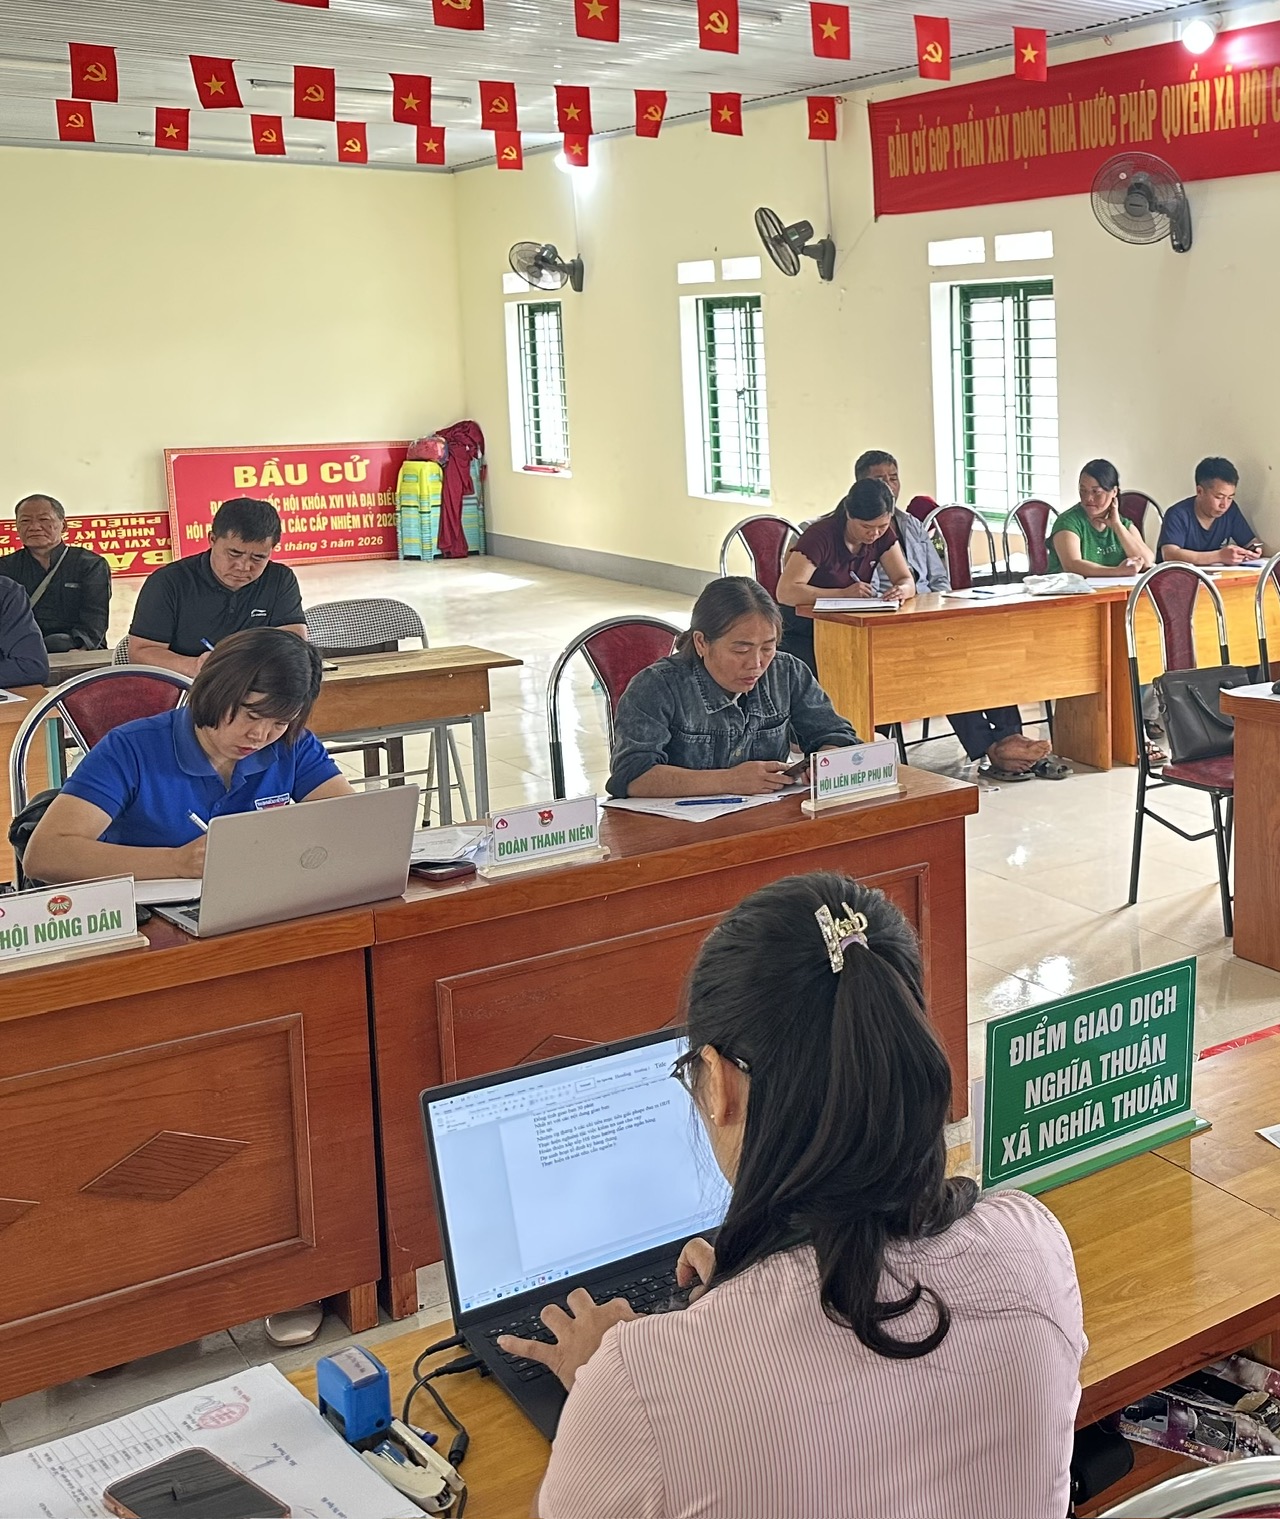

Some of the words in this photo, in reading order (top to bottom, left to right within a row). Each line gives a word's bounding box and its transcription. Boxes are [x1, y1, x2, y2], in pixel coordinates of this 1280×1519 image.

[888, 119, 909, 178] BẦU
[912, 114, 926, 175] CỬ
[929, 117, 950, 172] GÓP
[953, 104, 985, 168] PHẦN
[987, 105, 1009, 164] XÂY
[1013, 105, 1047, 170] DỰNG
[1049, 93, 1077, 154] NHÀ
[1079, 87, 1116, 150] NƯỚC
[1119, 79, 1157, 144] PHÁP
[1161, 63, 1210, 144] QUYỀN
[1213, 64, 1236, 131] XÃ
[1240, 65, 1267, 138] HỘI
[233, 457, 308, 488] BẦU
[320, 454, 371, 483] CỬ
[283, 494, 300, 515] HỘI
[301, 493, 327, 510] KHÓA
[329, 494, 344, 509] XVI
[345, 490, 358, 508] VÀ
[359, 493, 376, 510] ĐẠI
[101, 527, 155, 539] NHIỆM
[186, 521, 203, 542] HỘI
[288, 515, 307, 533] CÁC
[309, 511, 328, 531] CẤP
[330, 512, 361, 532] NHIỆM
[362, 511, 374, 528] KỲ
[99, 539, 120, 551] VÀ
[125, 538, 150, 548] XVI
[284, 540, 317, 552] tháng
[320, 539, 327, 548] 3
[330, 538, 354, 548] năm
[358, 536, 383, 547] 2026
[820, 775, 832, 793] HỘI
[833, 773, 849, 788] LIÊN
[850, 769, 866, 786] HIỆP
[867, 769, 881, 782] PHỤ
[883, 763, 894, 778] NỮ
[498, 836, 528, 856] ĐOÀN
[530, 830, 566, 850] THANH
[568, 824, 594, 843] NIÊN
[0, 923, 29, 951] HỘI
[34, 917, 82, 944] NÔNG
[87, 908, 122, 934] DÂN
[1009, 1016, 1067, 1066] ĐIỂM
[1073, 1003, 1123, 1045] GIAO
[1129, 985, 1178, 1028] DỊCH
[1025, 1057, 1093, 1110] NGHĨA
[1100, 1033, 1167, 1083] THUẬN
[1001, 1123, 1031, 1166] XÃ
[1038, 1100, 1105, 1152] NGHĨA
[1112, 1073, 1178, 1122] THUẬN
